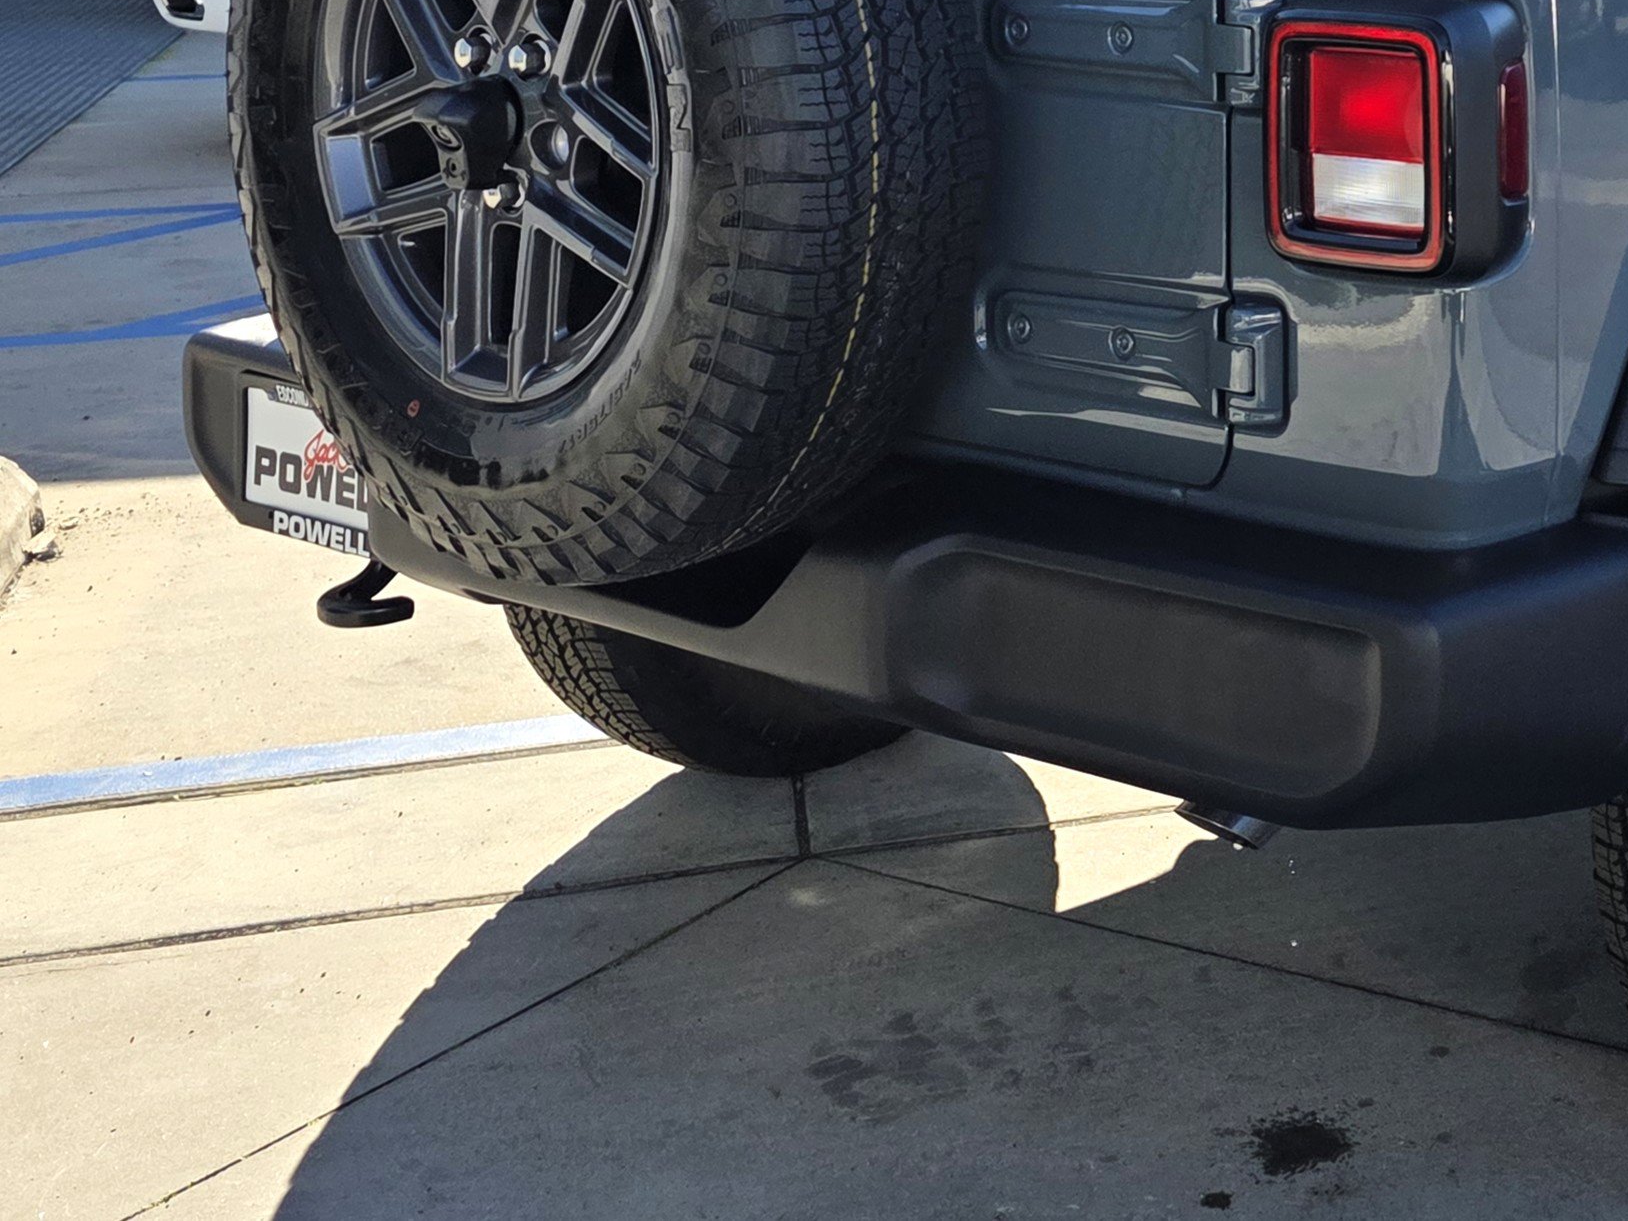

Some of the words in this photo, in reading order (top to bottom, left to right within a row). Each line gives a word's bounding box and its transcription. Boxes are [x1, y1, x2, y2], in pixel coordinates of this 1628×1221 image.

[275, 384, 309, 407] ESCOND
[254, 444, 368, 513] POWEL
[273, 510, 370, 557] POWELL
